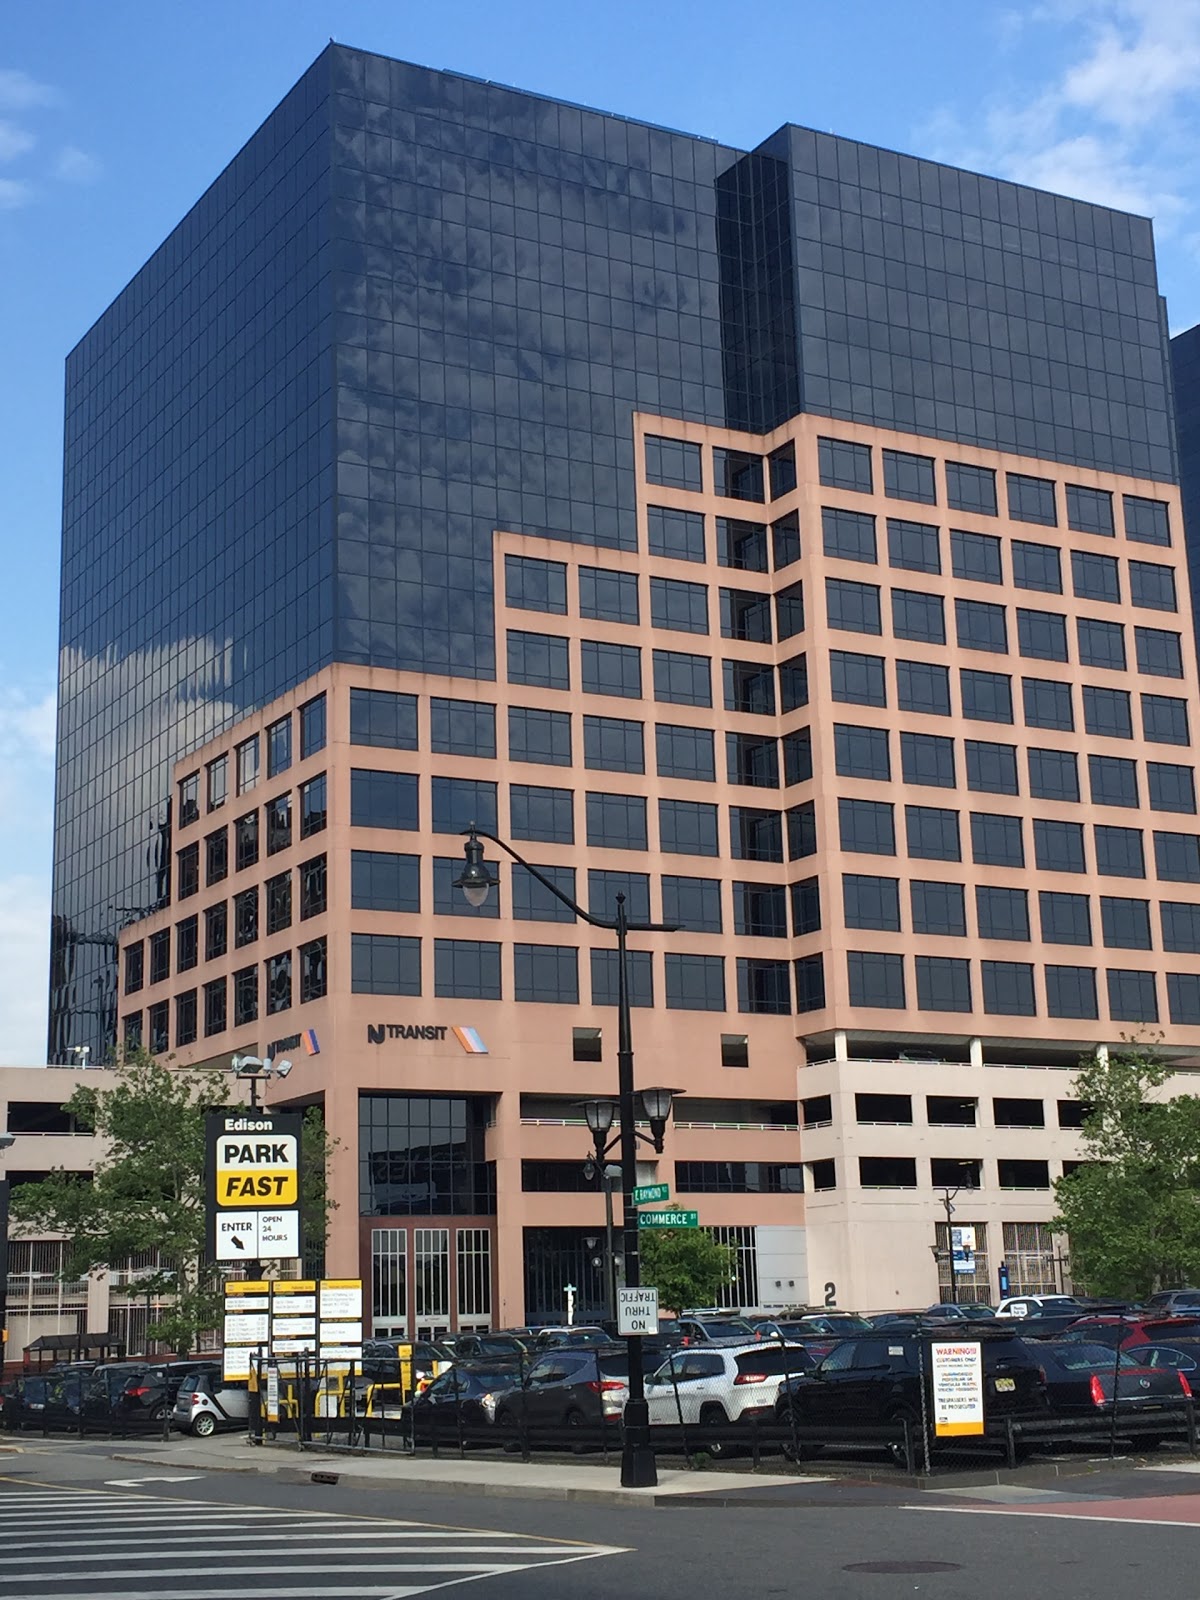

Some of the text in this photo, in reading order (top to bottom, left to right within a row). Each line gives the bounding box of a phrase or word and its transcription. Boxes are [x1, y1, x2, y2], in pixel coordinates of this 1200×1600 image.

[386, 1024, 448, 1041] TRANSIT
[224, 1118, 273, 1132] Edison
[224, 1143, 289, 1164] PARK
[225, 1175, 289, 1198] FAST
[634, 1189, 640, 1201] E
[262, 1215, 283, 1223] OPEN
[639, 1213, 688, 1225] COMMERCE
[221, 1222, 253, 1232] ENTER
[262, 1225, 272, 1233] 24
[262, 1234, 288, 1242] HOURS
[620, 1291, 656, 1303] TRAFFIC
[824, 1281, 837, 1307] 2
[625, 1306, 650, 1317] THRU
[631, 1319, 646, 1331] NO
